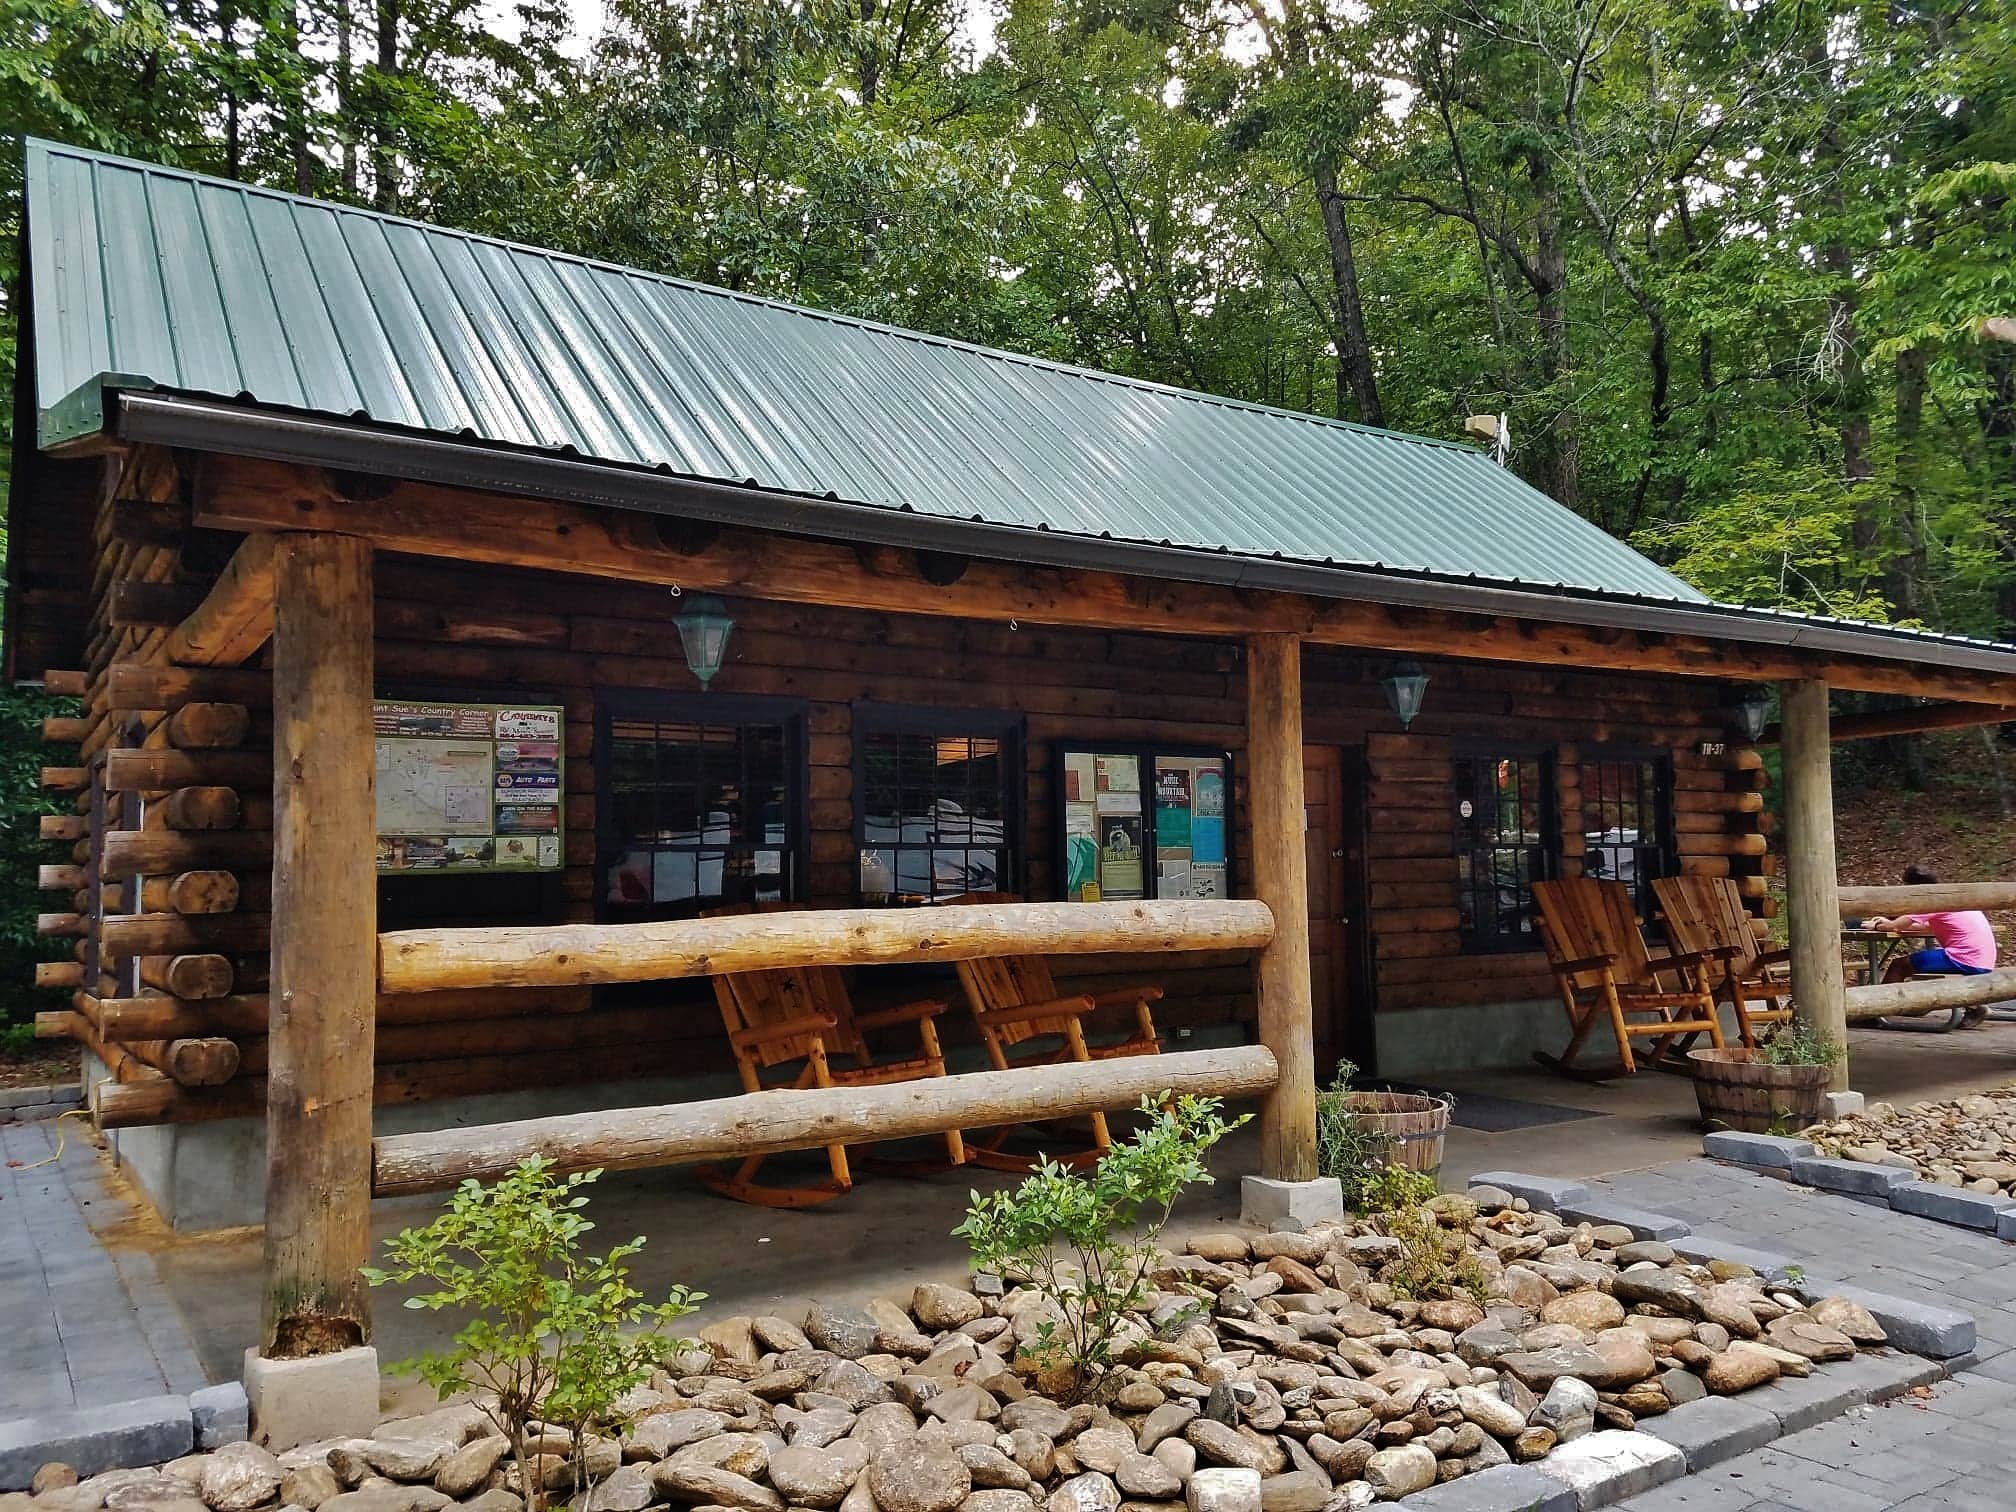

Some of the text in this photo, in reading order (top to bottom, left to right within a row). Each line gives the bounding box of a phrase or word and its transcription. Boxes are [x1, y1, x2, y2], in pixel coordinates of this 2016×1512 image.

[374, 704, 489, 717] unt Sue's Country Corner
[537, 776, 556, 784] PARTS
